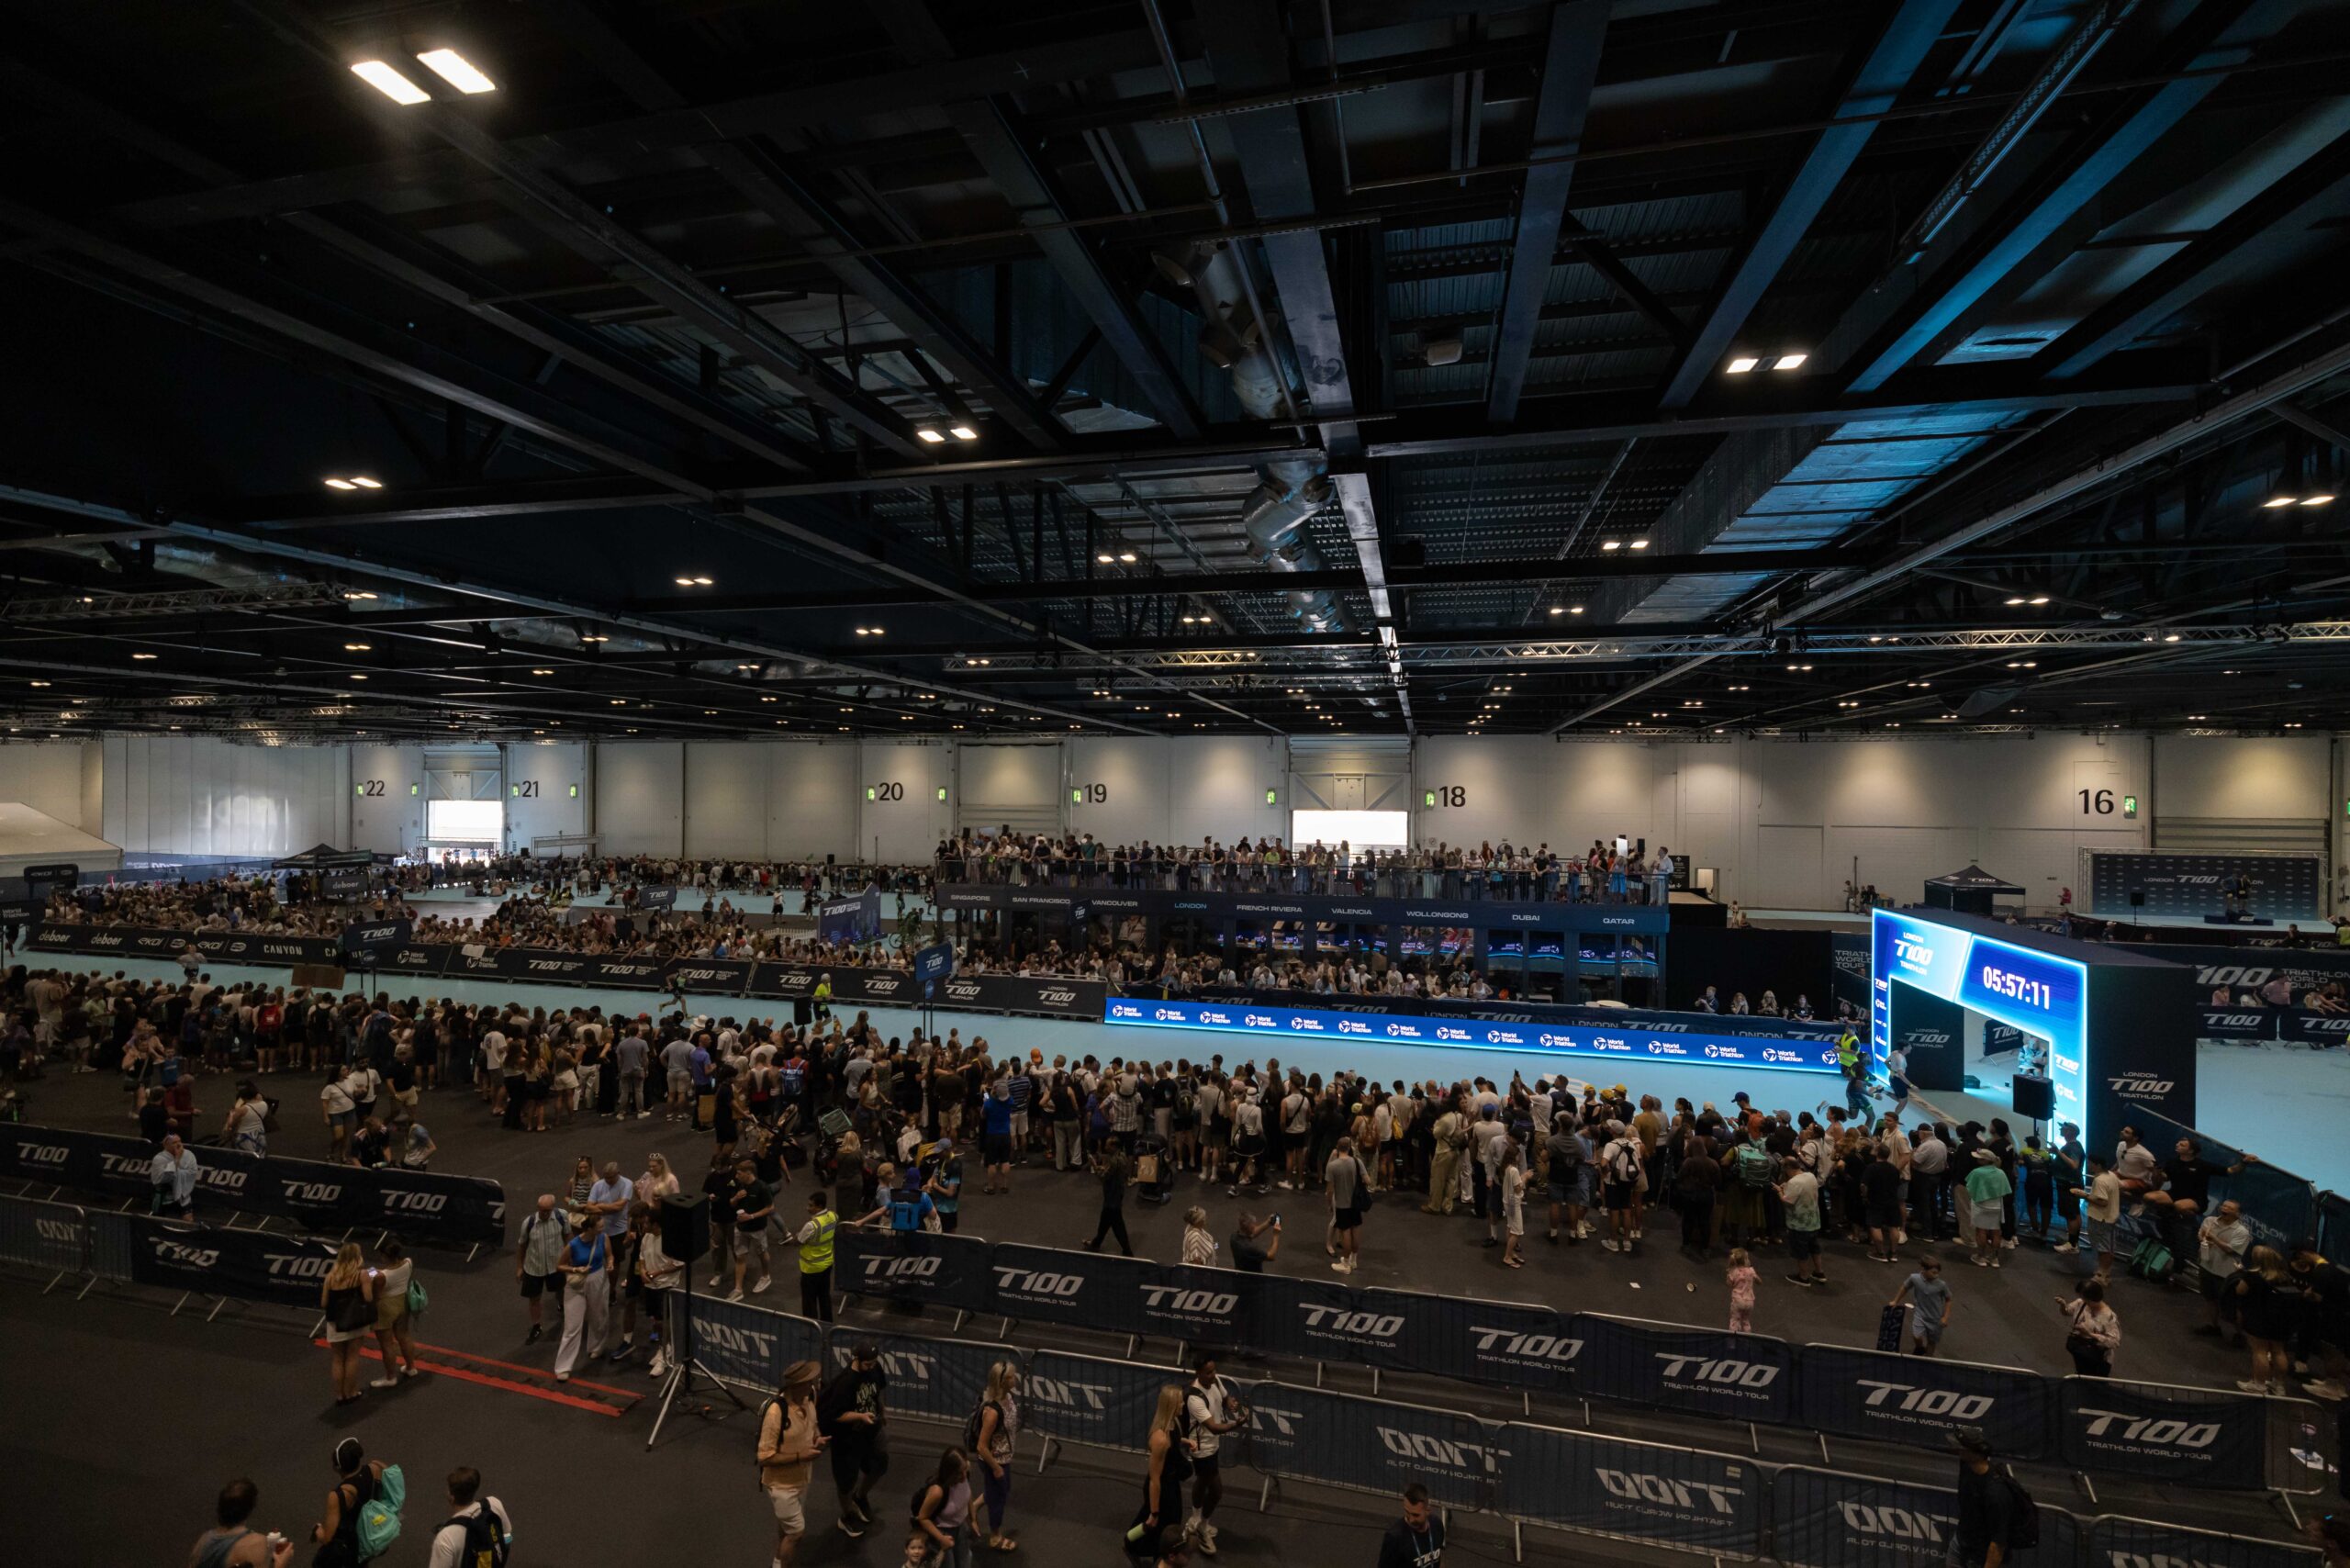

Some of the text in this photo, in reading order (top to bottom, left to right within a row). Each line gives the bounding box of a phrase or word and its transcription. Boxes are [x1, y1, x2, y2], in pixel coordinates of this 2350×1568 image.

[366, 779, 385, 797] 22
[522, 779, 539, 797] 21
[878, 782, 904, 801] 20
[1083, 783, 1107, 803] 19
[1438, 786, 1466, 808] 18
[2078, 789, 2115, 815] 16
[332, 880, 359, 890] deboer
[2177, 875, 2220, 884] T100
[649, 890, 668, 899] T100
[1406, 911, 1469, 919] WOLLONGONG
[39, 929, 71, 943] deboer
[91, 933, 123, 946] deboer
[360, 927, 397, 938] T100
[1903, 932, 1924, 944] LONDON
[263, 944, 303, 956] CANYON
[1895, 938, 1933, 965] T100
[529, 960, 562, 970] T100
[600, 964, 635, 975] T100
[779, 975, 812, 985] T100
[864, 980, 900, 991] T100
[1983, 966, 2050, 1011] 05:57:11
[945, 984, 981, 995] T100
[1037, 990, 1076, 1002] T100
[2203, 1014, 2262, 1026] T100
[1786, 1030, 1839, 1042] T10
[1904, 1032, 1950, 1044] T100
[2108, 1078, 2175, 1093] T100
[2118, 1092, 2165, 1101] TRIATHLON
[17, 1142, 70, 1163] T100
[101, 1153, 152, 1174] T100
[196, 1165, 248, 1188] T100
[280, 1180, 342, 1202] T100
[379, 1189, 448, 1212] T100
[263, 1254, 337, 1278] T100
[859, 1254, 943, 1276] T100
[992, 1266, 1085, 1296] T100
[999, 1292, 1033, 1301] TRIATHLON
[1034, 1296, 1058, 1305] WORLD
[1139, 1284, 1238, 1315] T100
[1147, 1310, 1183, 1320] TRIATHLON
[1184, 1315, 1210, 1323] WORLD
[1298, 1303, 1405, 1337] T100
[1305, 1330, 1396, 1349] TRIATHLON WORLD TOUR
[1469, 1326, 1584, 1361] T100
[1476, 1354, 1575, 1372] TRIATHLON WORLD TOUR
[1654, 1352, 1780, 1387] T100
[1662, 1381, 1769, 1401] TRIATHLON WORLD TOUR
[1856, 1379, 1995, 1419] T100
[1865, 1409, 1917, 1423] TRIATHLON
[1919, 1418, 1953, 1428] WORLD
[2077, 1407, 2222, 1448] T100
[2087, 1440, 2212, 1462] TRIATHLON WORLD TOUR
